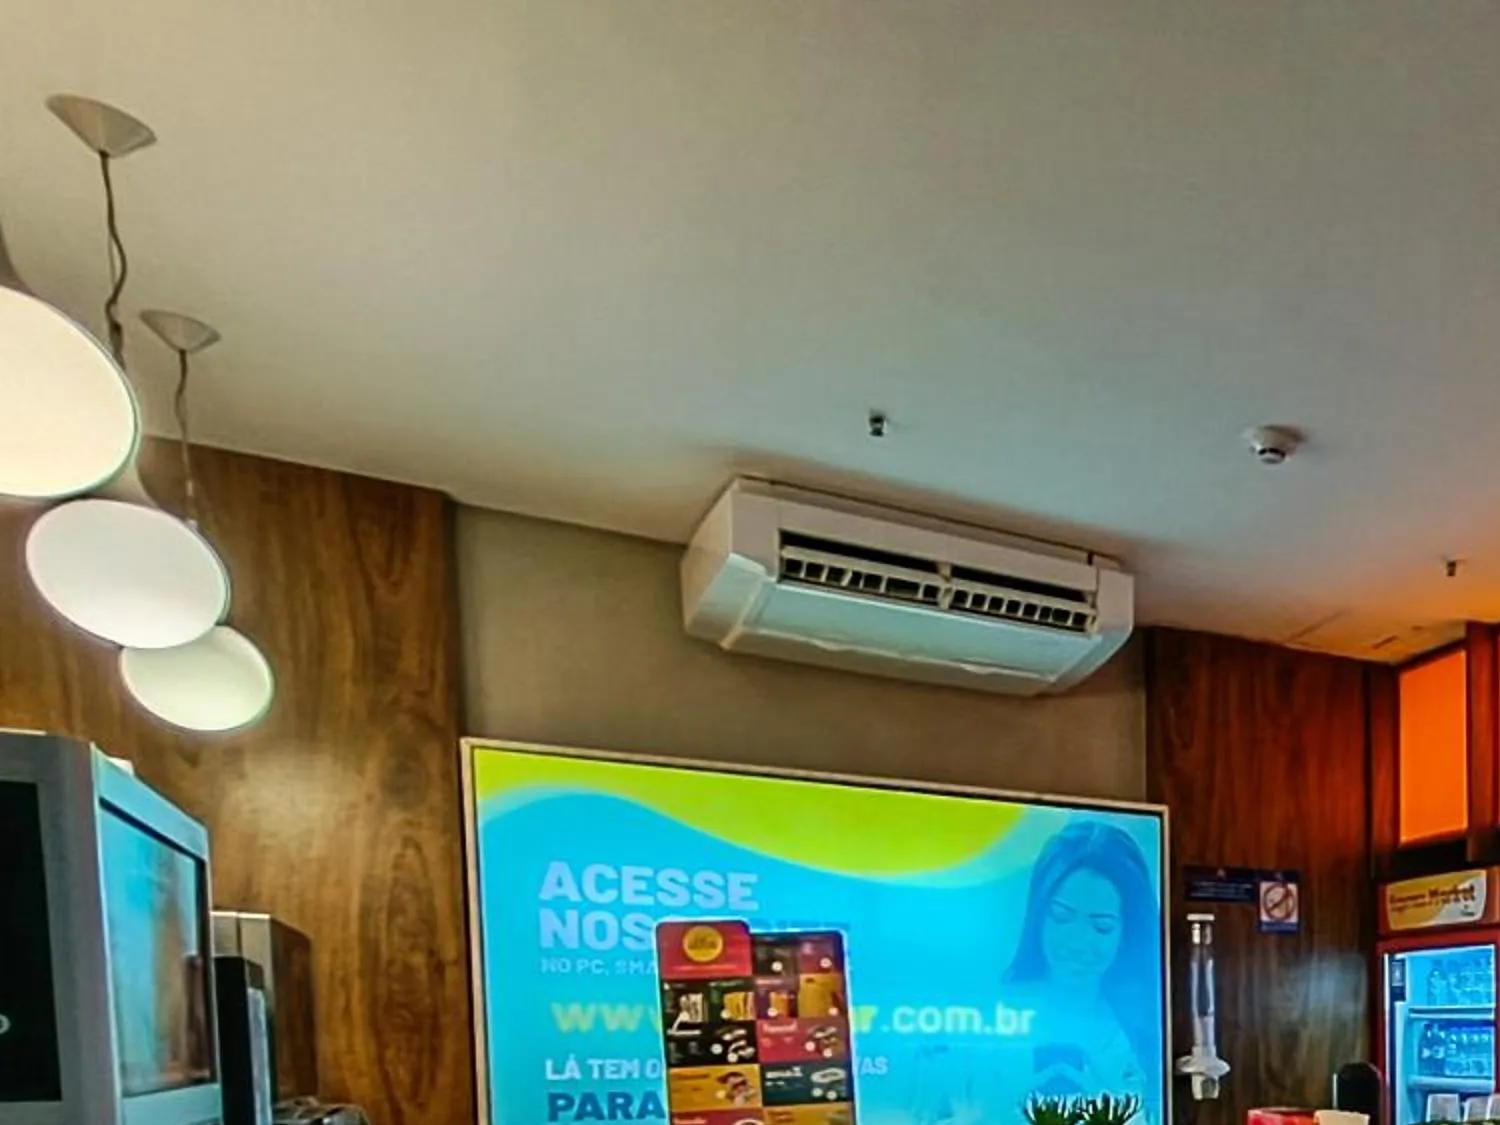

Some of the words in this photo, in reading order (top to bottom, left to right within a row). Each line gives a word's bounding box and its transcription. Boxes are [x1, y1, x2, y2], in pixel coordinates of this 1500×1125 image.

[538, 860, 760, 911] ACESSE
[538, 908, 656, 951] NOS
[541, 957, 571, 974] NO
[544, 1053, 582, 1081] LÁ
[586, 1058, 639, 1081] TEM
[547, 1090, 667, 1122] PARA
